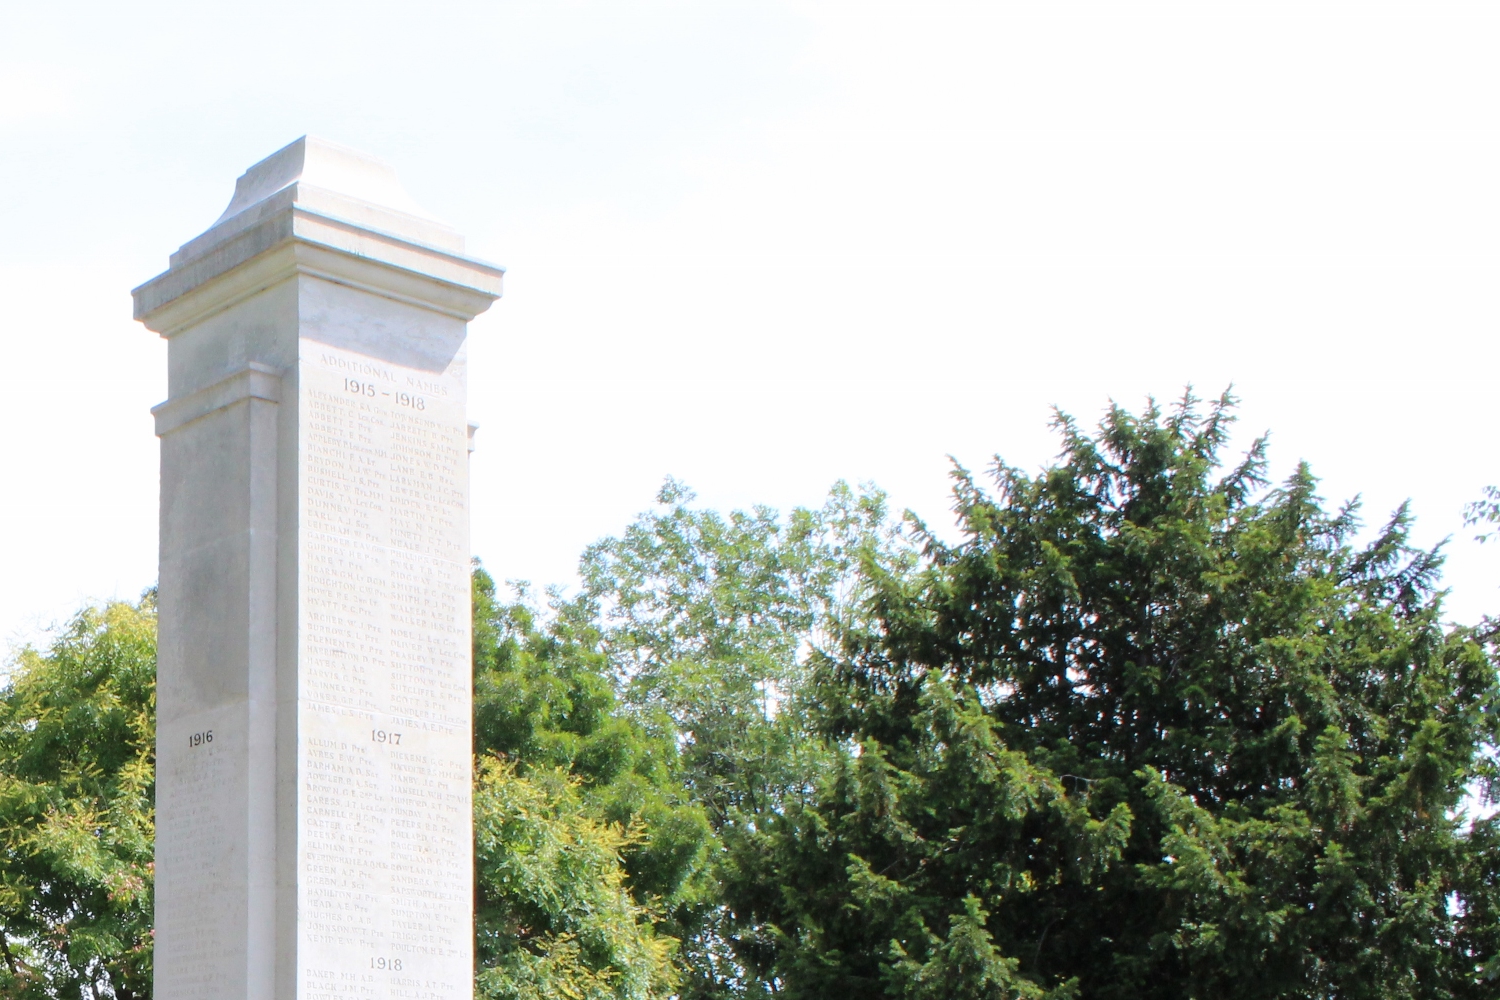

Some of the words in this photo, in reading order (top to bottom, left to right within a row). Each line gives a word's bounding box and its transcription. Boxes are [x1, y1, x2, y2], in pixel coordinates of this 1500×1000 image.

[320, 353, 397, 384] ADDITIONAL
[406, 377, 448, 397] NAMES
[344, 377, 376, 399] 1915
[395, 390, 425, 412] 1918
[189, 730, 213, 747] 1916
[372, 729, 402, 746] 1917
[371, 956, 403, 972] 1918
